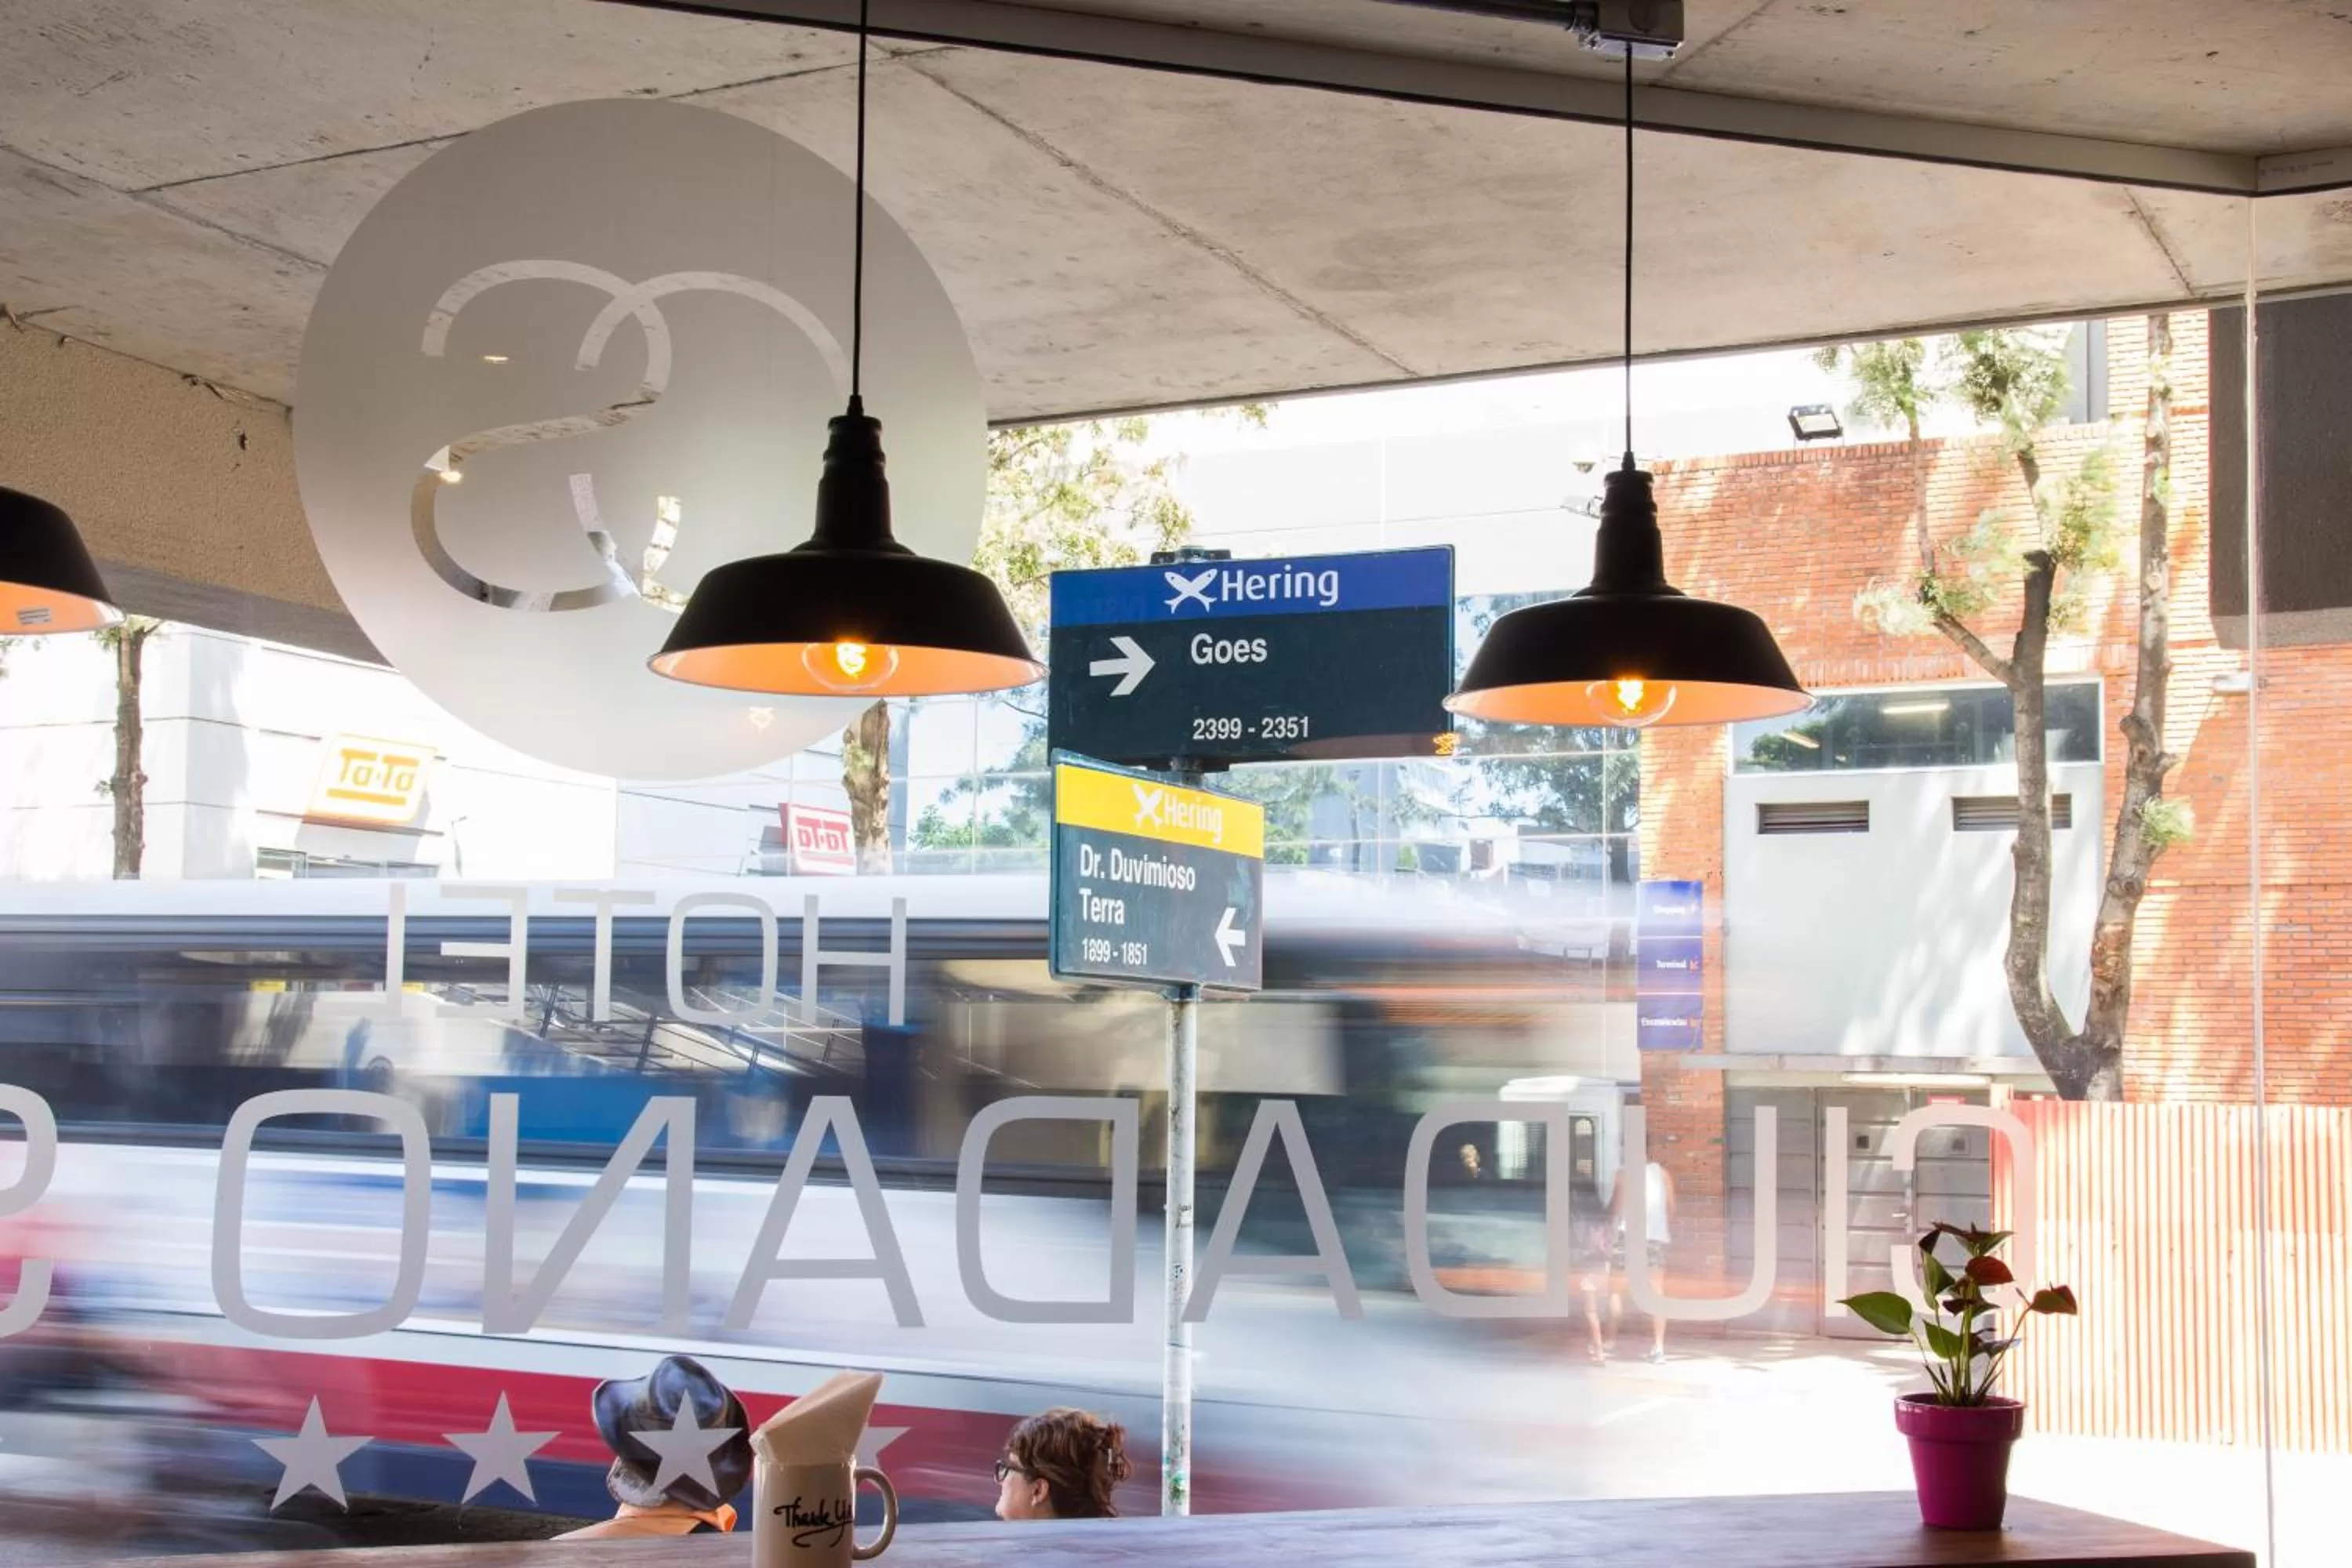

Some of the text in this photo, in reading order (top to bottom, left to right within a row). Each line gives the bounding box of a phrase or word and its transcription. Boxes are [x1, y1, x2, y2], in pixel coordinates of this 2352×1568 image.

[1221, 564, 1339, 607] Hering
[1191, 633, 1268, 665] Goes
[1192, 717, 1242, 740] 2399
[1261, 715, 1309, 739] 2351
[1163, 792, 1222, 844] Hering
[1080, 843, 1196, 891] Dr. Duvimioso
[1079, 887, 1124, 925] Terra
[1082, 938, 1111, 964] 1899
[1121, 942, 1149, 966] 1851
[773, 1496, 835, 1529] Thank
